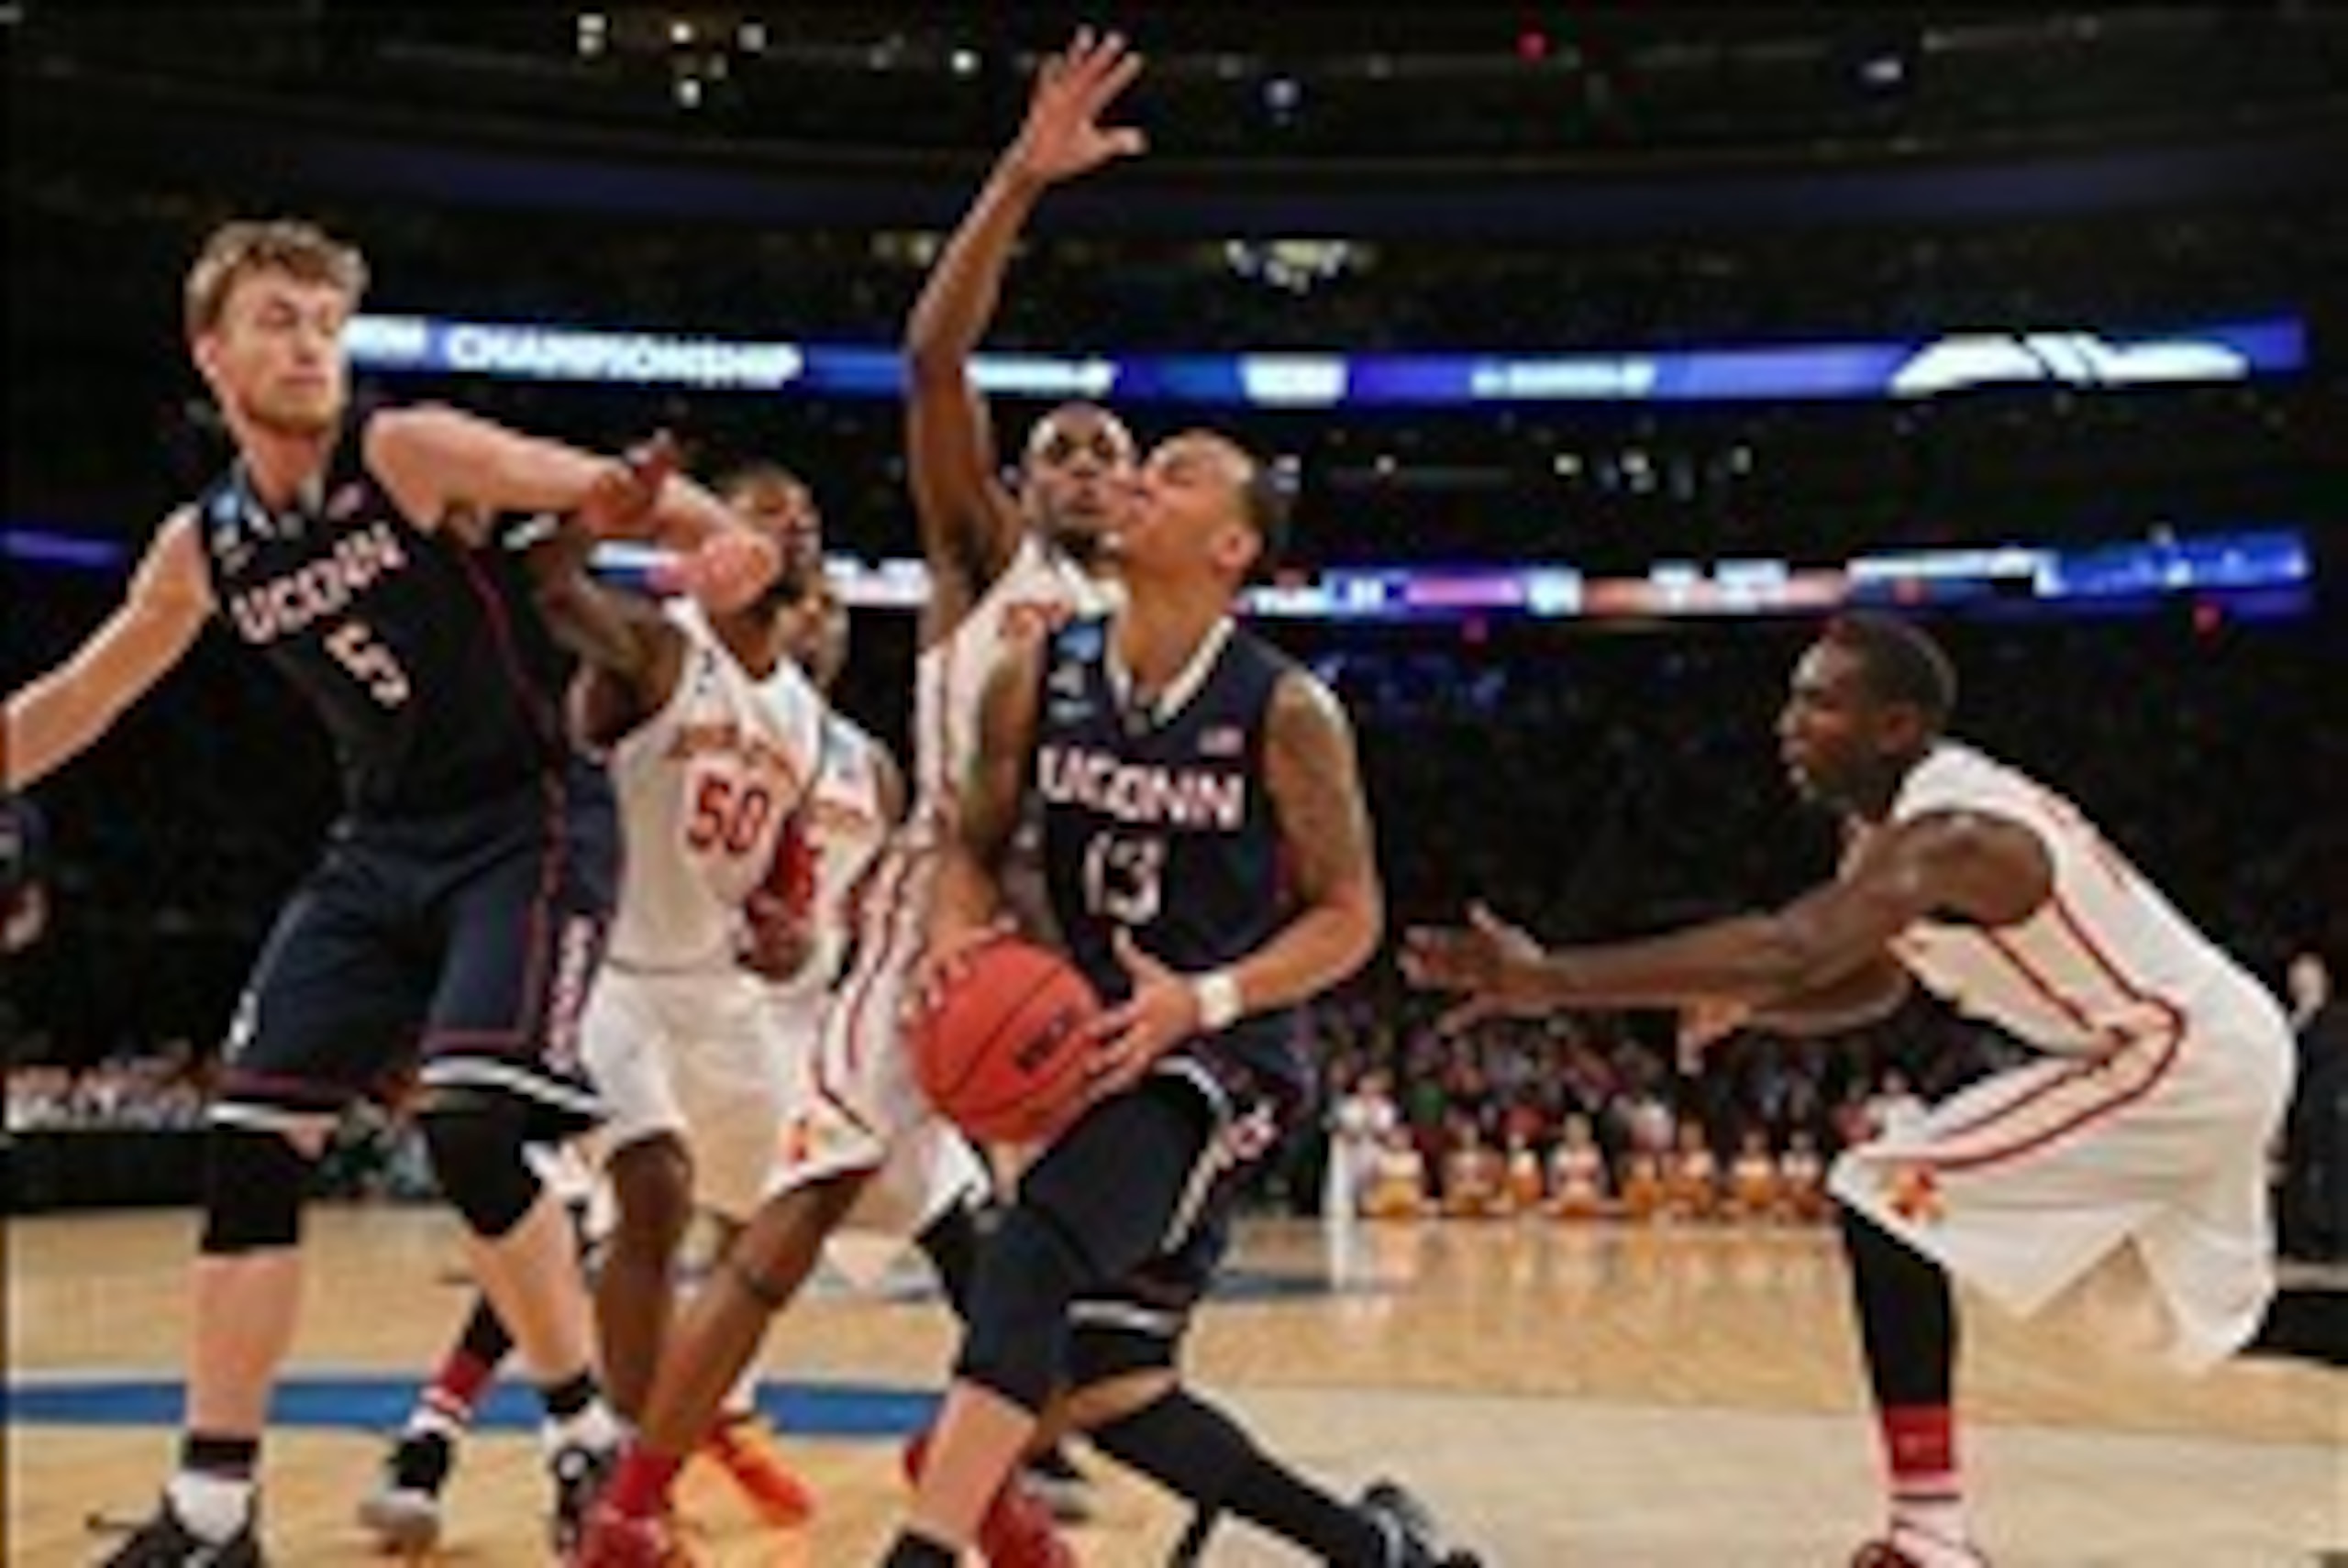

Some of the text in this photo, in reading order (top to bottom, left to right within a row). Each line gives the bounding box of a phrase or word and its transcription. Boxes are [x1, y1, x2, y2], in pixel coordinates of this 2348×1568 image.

[228, 520, 409, 646] UCONN
[321, 620, 411, 710] 5
[685, 772, 770, 854] 50
[1037, 747, 1245, 827] UCONN
[1081, 831, 1163, 922] 13
